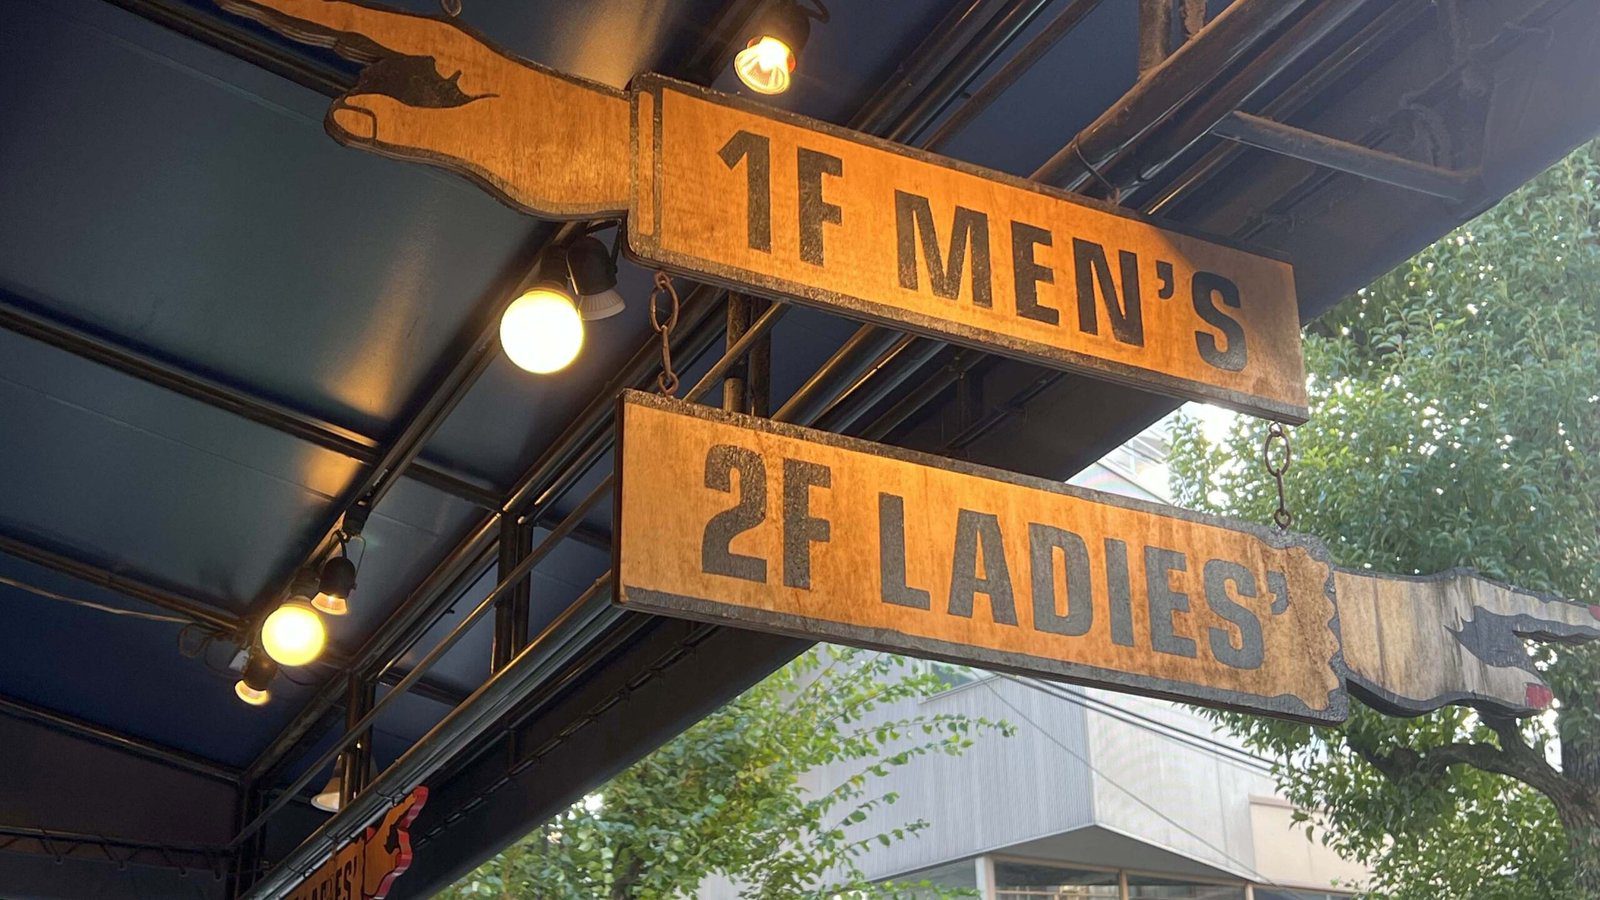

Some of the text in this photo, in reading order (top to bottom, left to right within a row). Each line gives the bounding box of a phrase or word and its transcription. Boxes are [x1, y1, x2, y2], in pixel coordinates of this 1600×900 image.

[716, 129, 1249, 373] 1F MEN'S
[702, 443, 1289, 671] 2F LADIES'
[303, 855, 358, 900] DIES'
